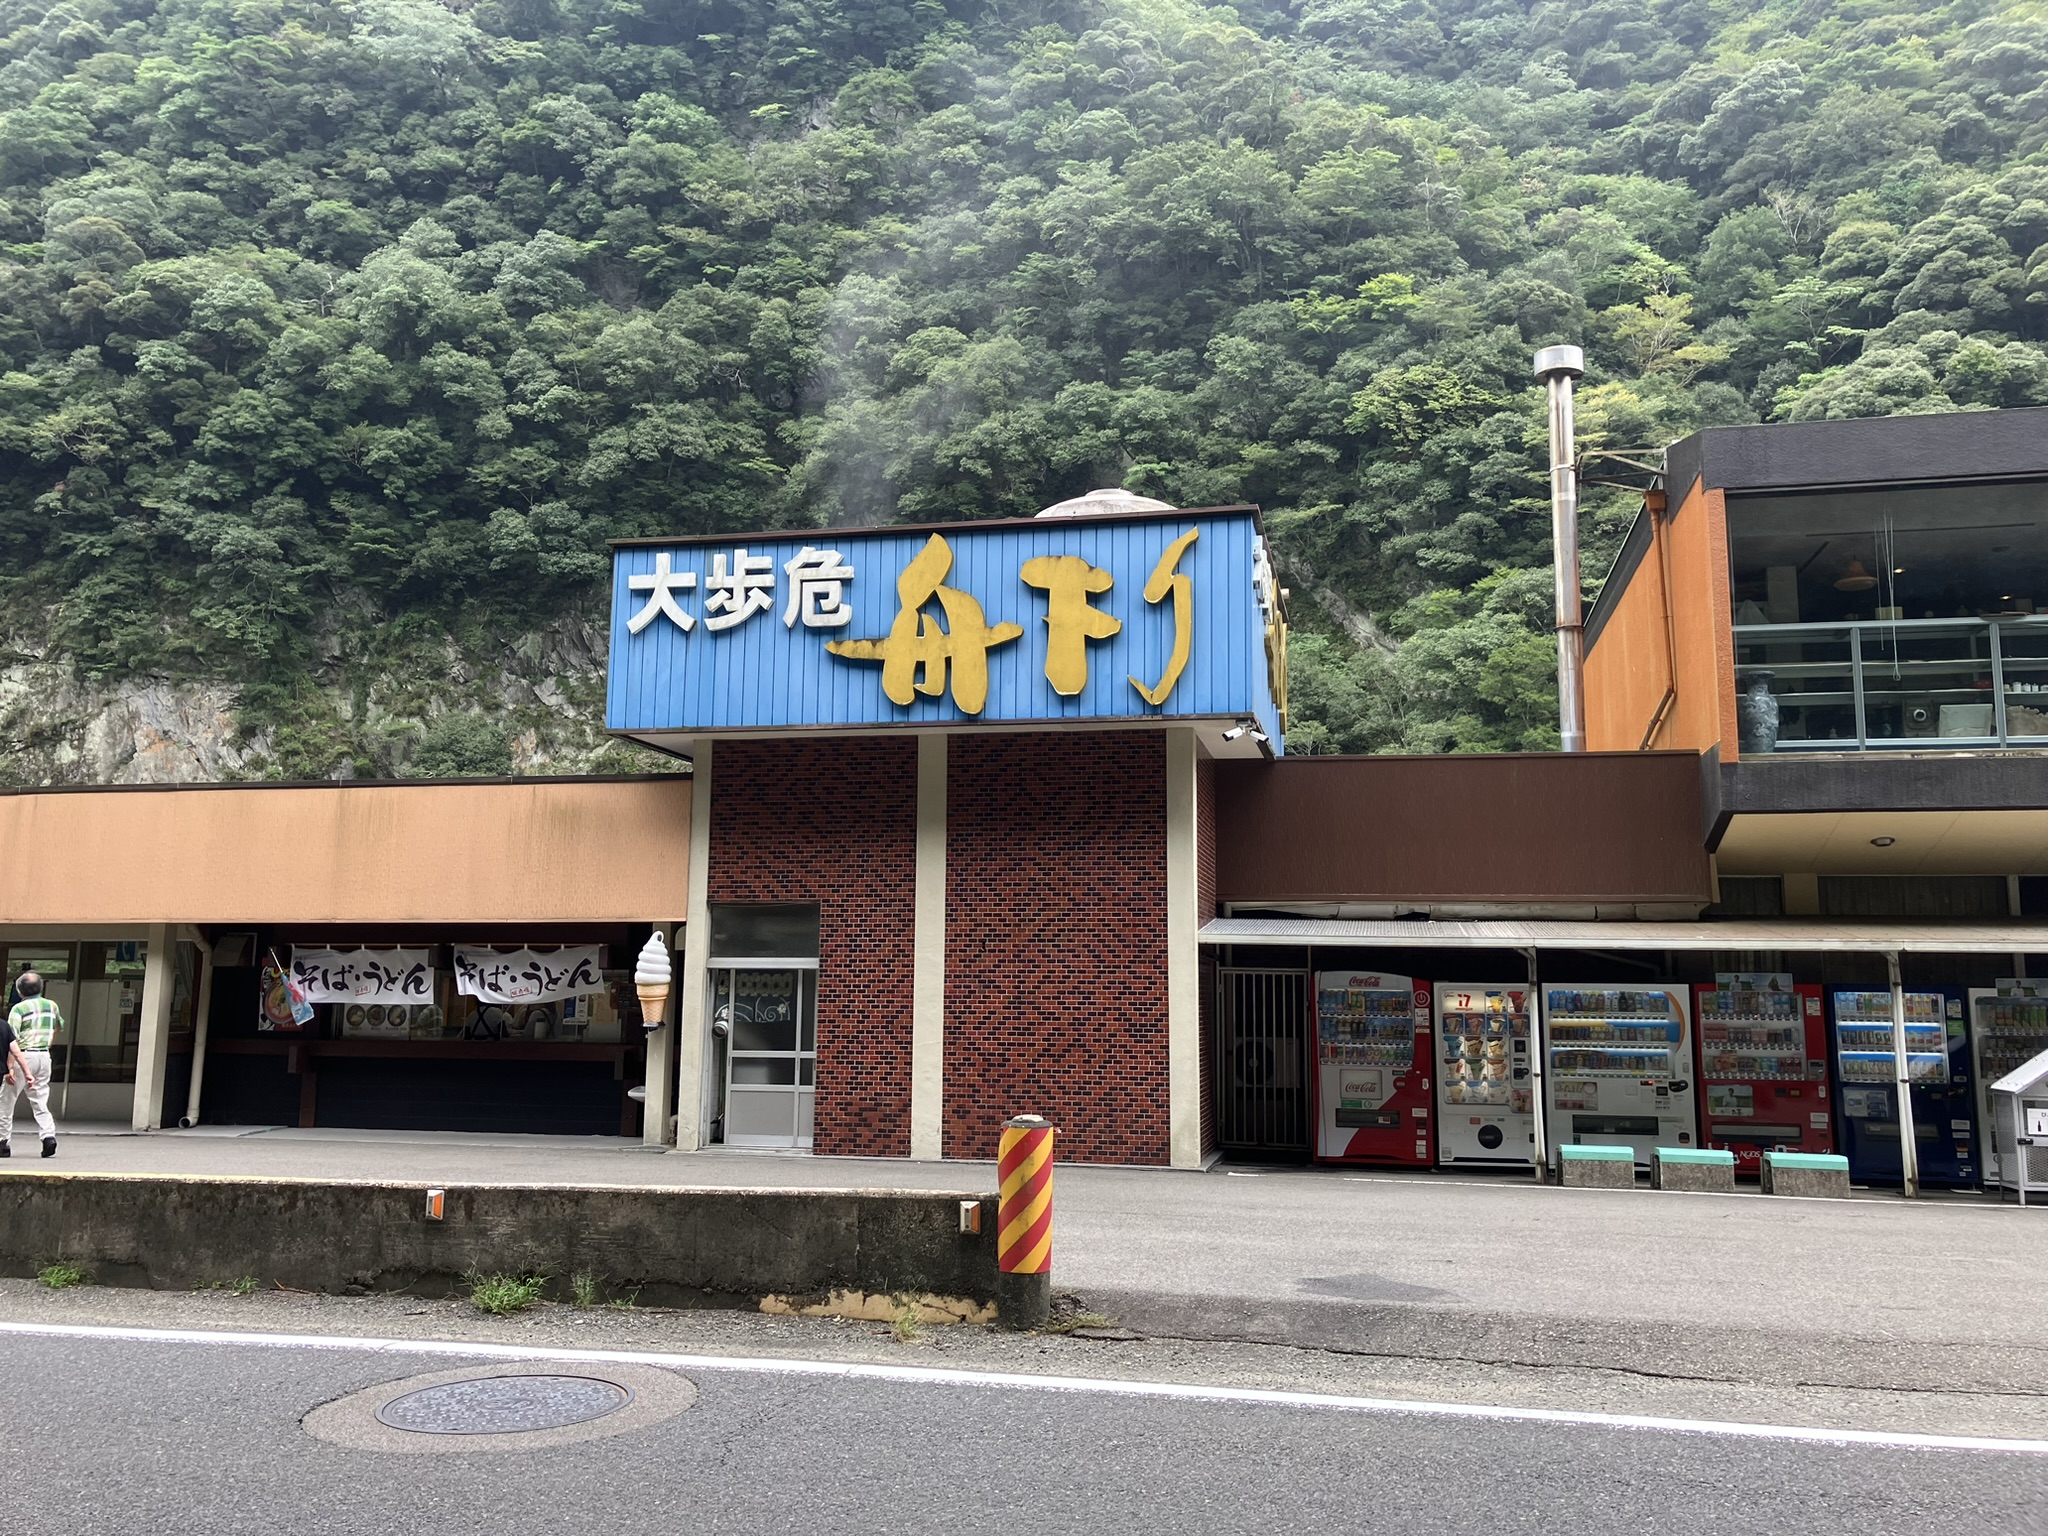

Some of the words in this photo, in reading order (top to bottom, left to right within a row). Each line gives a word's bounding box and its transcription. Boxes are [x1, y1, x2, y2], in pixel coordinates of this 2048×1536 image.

[626, 547, 855, 635] 大歩危
[824, 526, 1199, 715] 舟下り
[293, 961, 432, 996] そば・うどん
[455, 955, 601, 997] そば・うどん
